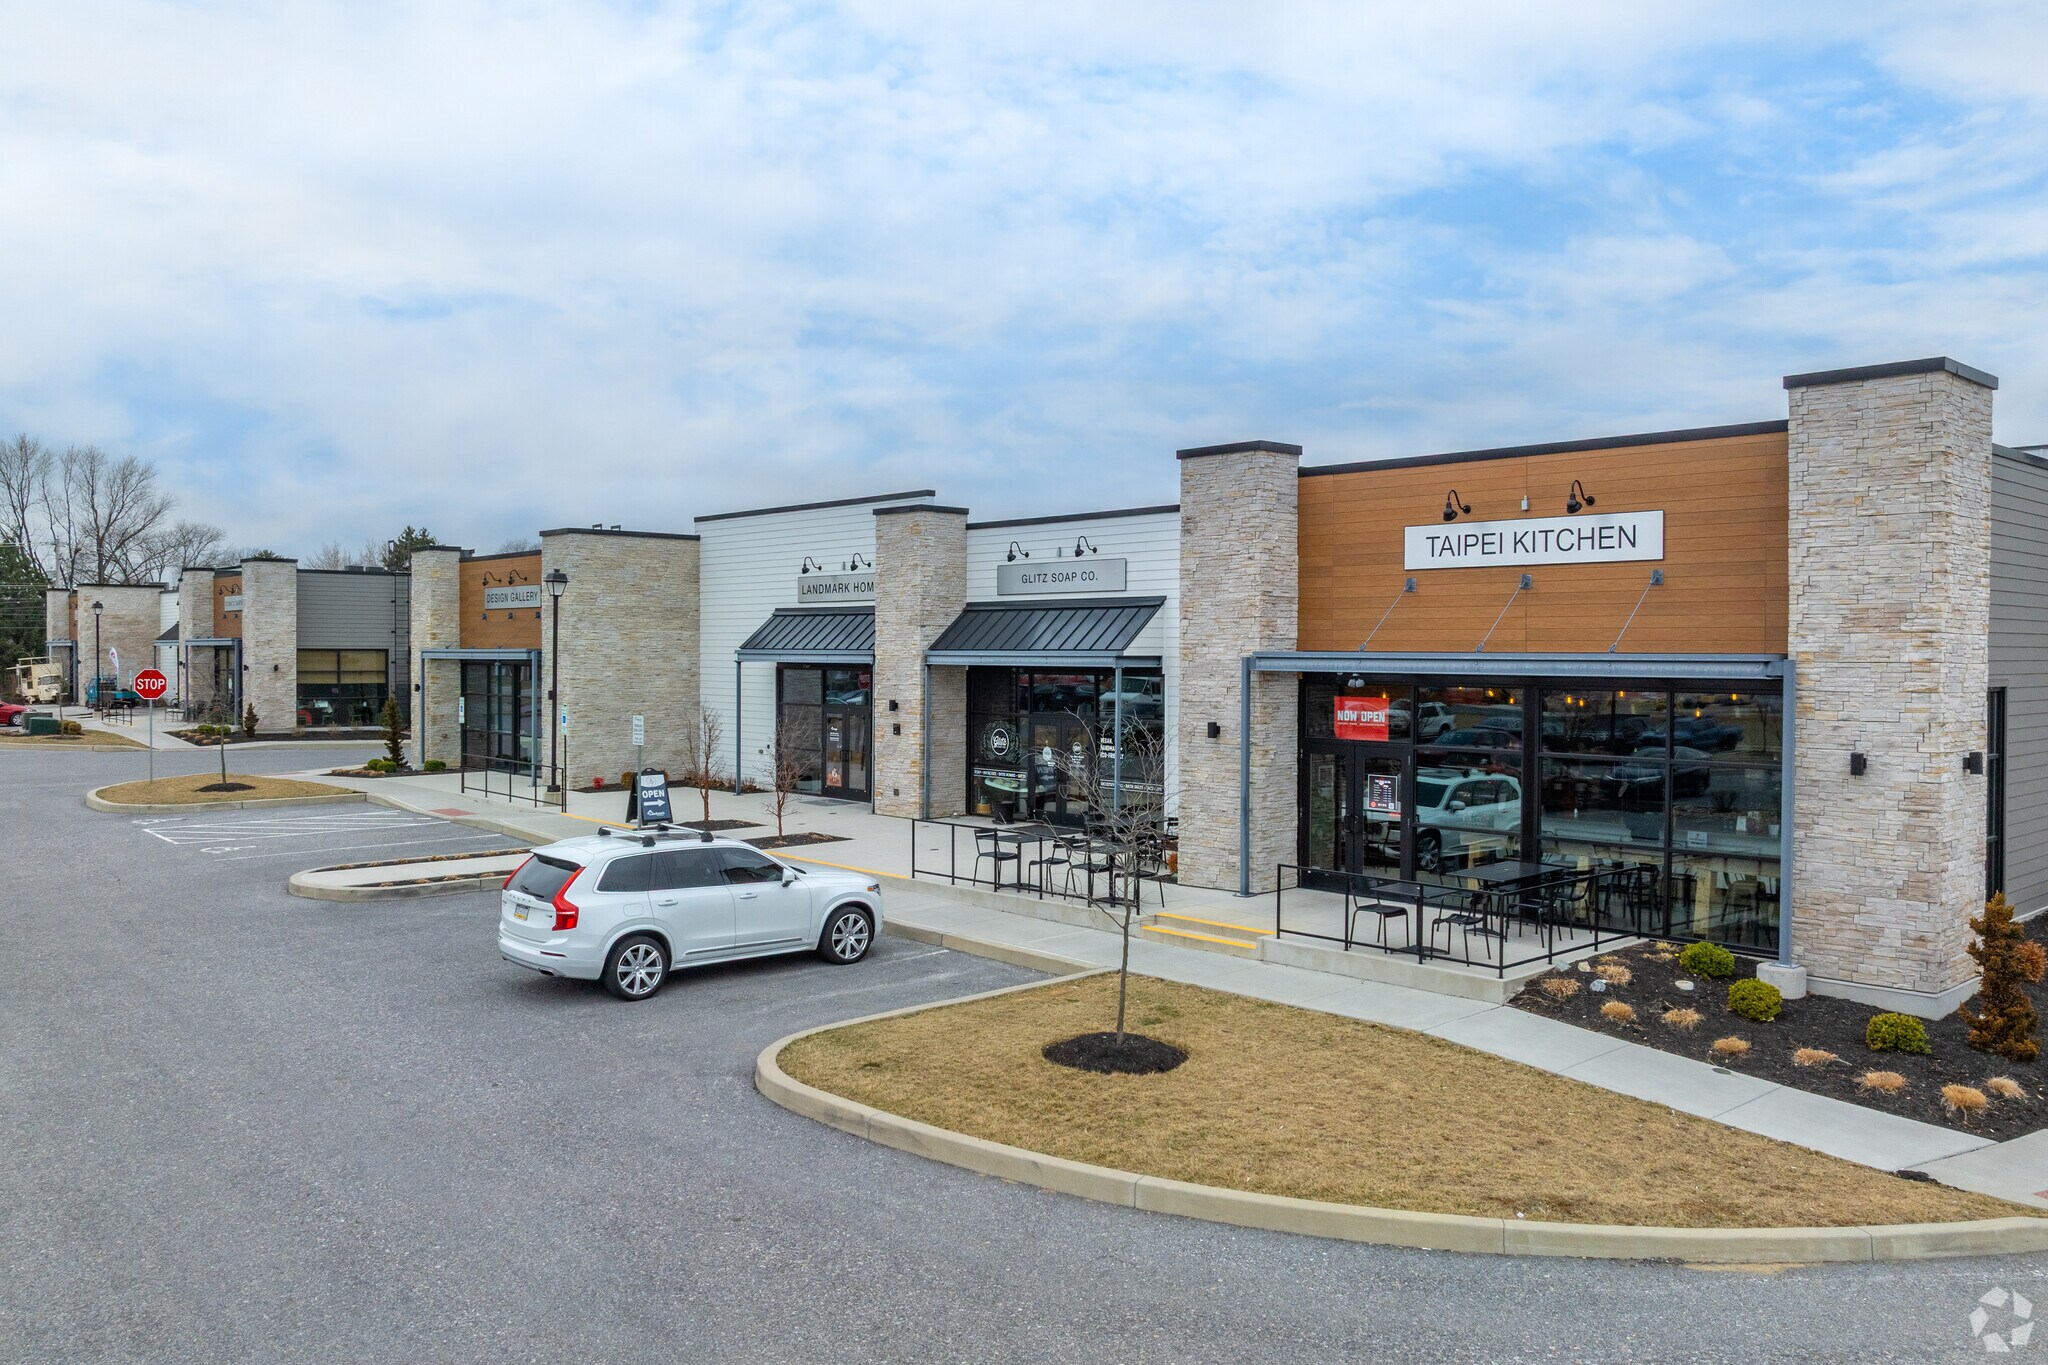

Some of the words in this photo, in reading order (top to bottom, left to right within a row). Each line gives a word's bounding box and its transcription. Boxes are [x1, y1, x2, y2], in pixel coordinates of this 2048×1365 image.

[1425, 532, 1503, 558] TAIPEI
[1513, 524, 1637, 554] KITCHEN
[1021, 573, 1048, 584] GLITZ
[1051, 571, 1078, 583] SOAP
[1080, 570, 1099, 582] CO.
[801, 582, 850, 595] LANDMARK
[853, 581, 875, 593] HOM
[486, 592, 509, 604] DESIGN
[510, 591, 539, 602] GALLERY
[136, 678, 166, 690] STOP
[1337, 710, 1358, 722] NOW
[1360, 711, 1386, 723] OPEN
[641, 789, 665, 799] OPEN
